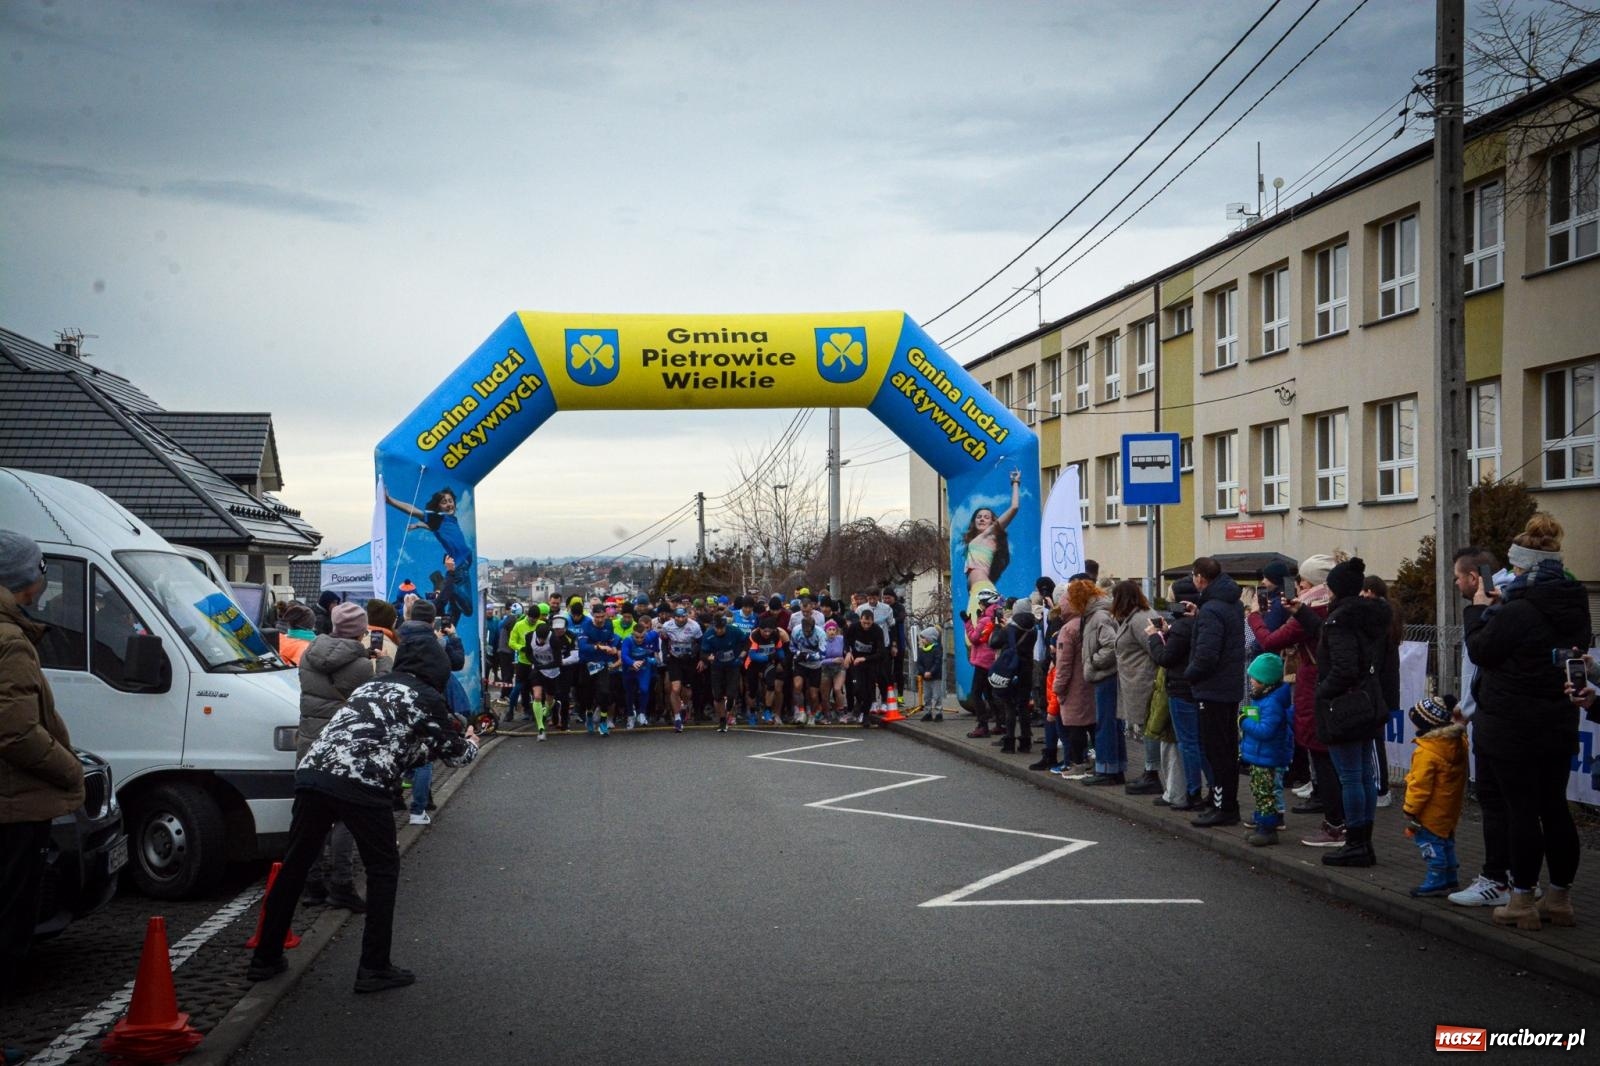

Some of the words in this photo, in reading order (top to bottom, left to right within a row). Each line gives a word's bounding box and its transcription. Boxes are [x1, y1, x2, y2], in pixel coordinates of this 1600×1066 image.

[642, 347, 796, 368] Pietrowice
[667, 328, 768, 344] Gmina
[417, 396, 478, 451] Gmina
[472, 348, 526, 398] ludzi
[661, 370, 776, 390] Wielkie
[907, 347, 962, 403] Gmina
[960, 396, 1009, 443] ludzi
[442, 373, 543, 469] aktywnych
[891, 371, 988, 462] aktywnych
[989, 672, 1010, 686] NIKE
